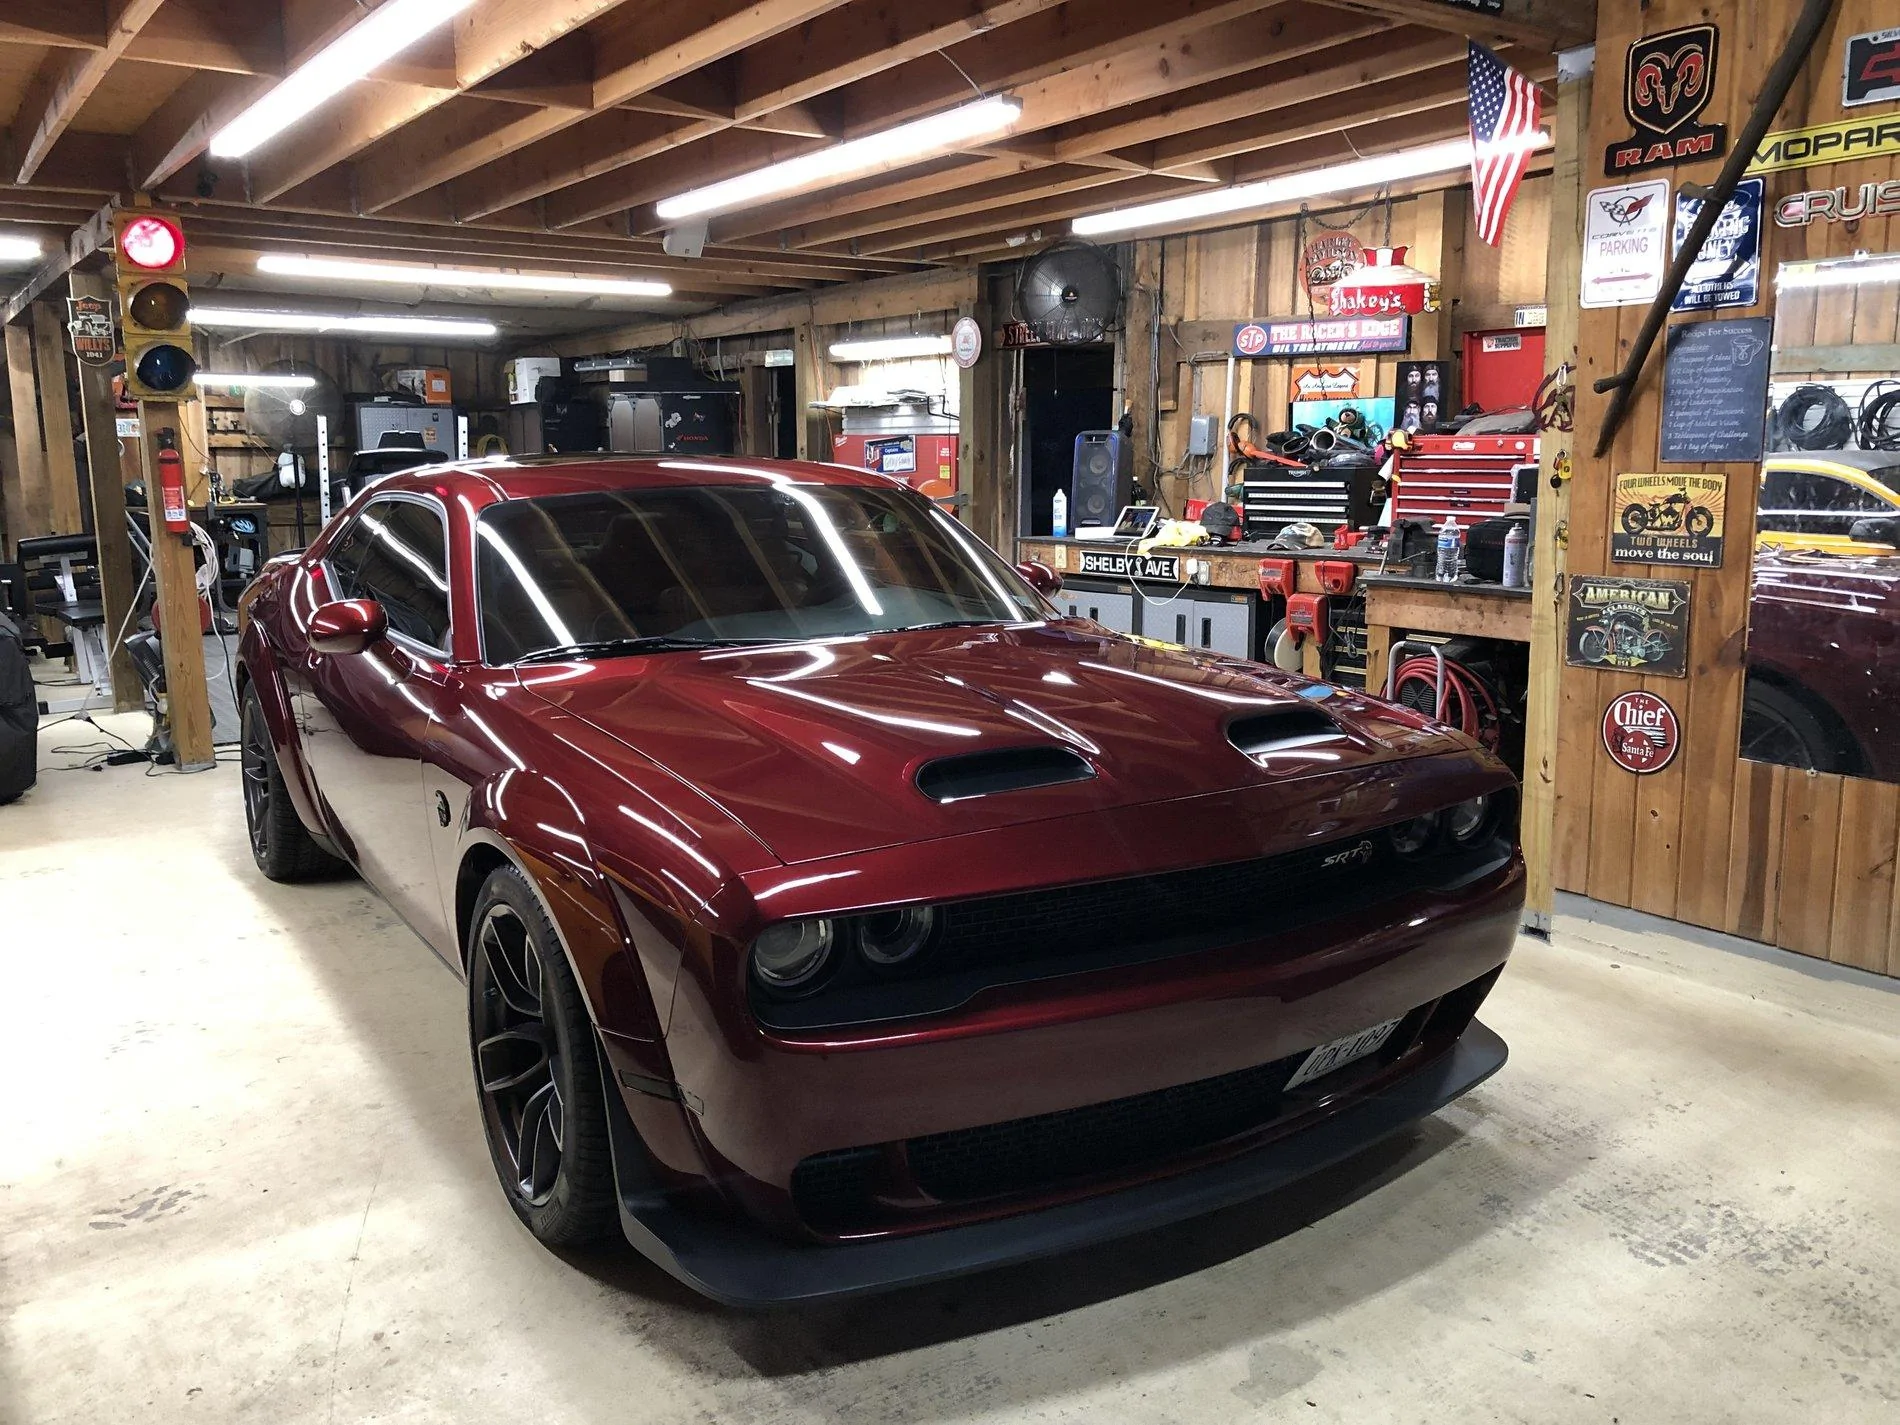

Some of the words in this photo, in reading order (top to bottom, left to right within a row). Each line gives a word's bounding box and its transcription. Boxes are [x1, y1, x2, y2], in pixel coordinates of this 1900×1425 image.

[1615, 133, 1714, 168] RAM
[1600, 237, 1648, 256] PARKING
[1330, 287, 1402, 315] Shakey's
[1684, 293, 1701, 304] WILL
[1703, 293, 1713, 302] BE
[1714, 290, 1740, 301] TOWED
[75, 301, 101, 312] Jeep
[1271, 326, 1297, 342] THE
[1361, 319, 1400, 337] EDGE
[1681, 329, 1706, 339] Recipe
[1708, 327, 1720, 336] For
[1723, 326, 1753, 335] Success
[75, 337, 111, 351] WILLYS
[1239, 329, 1264, 349] STP
[1272, 343, 1290, 353] OIL
[1292, 341, 1360, 352] TREATMENT
[1717, 430, 1749, 441] Challenge
[1619, 480, 1637, 490] FOUR
[1637, 476, 1666, 487] WHEELS
[1666, 476, 1687, 487] MOVE
[1688, 477, 1701, 488] THE
[1702, 478, 1723, 492] BODY
[1630, 536, 1653, 546] TWO
[1656, 537, 1698, 549] WHEELS
[1615, 548, 1654, 559] move
[1657, 546, 1680, 560] the
[1682, 550, 1714, 565] soul
[1085, 556, 1134, 573] SHELBY
[1145, 562, 1173, 577] AVE.
[1584, 586, 1671, 610] AMERICAN
[1606, 603, 1648, 616] CLASSICS
[1635, 697, 1649, 705] THE
[1613, 700, 1666, 726] Chief
[1622, 742, 1645, 756] Santa
[1645, 747, 1654, 757] Fe
[1320, 847, 1362, 868] SRT
